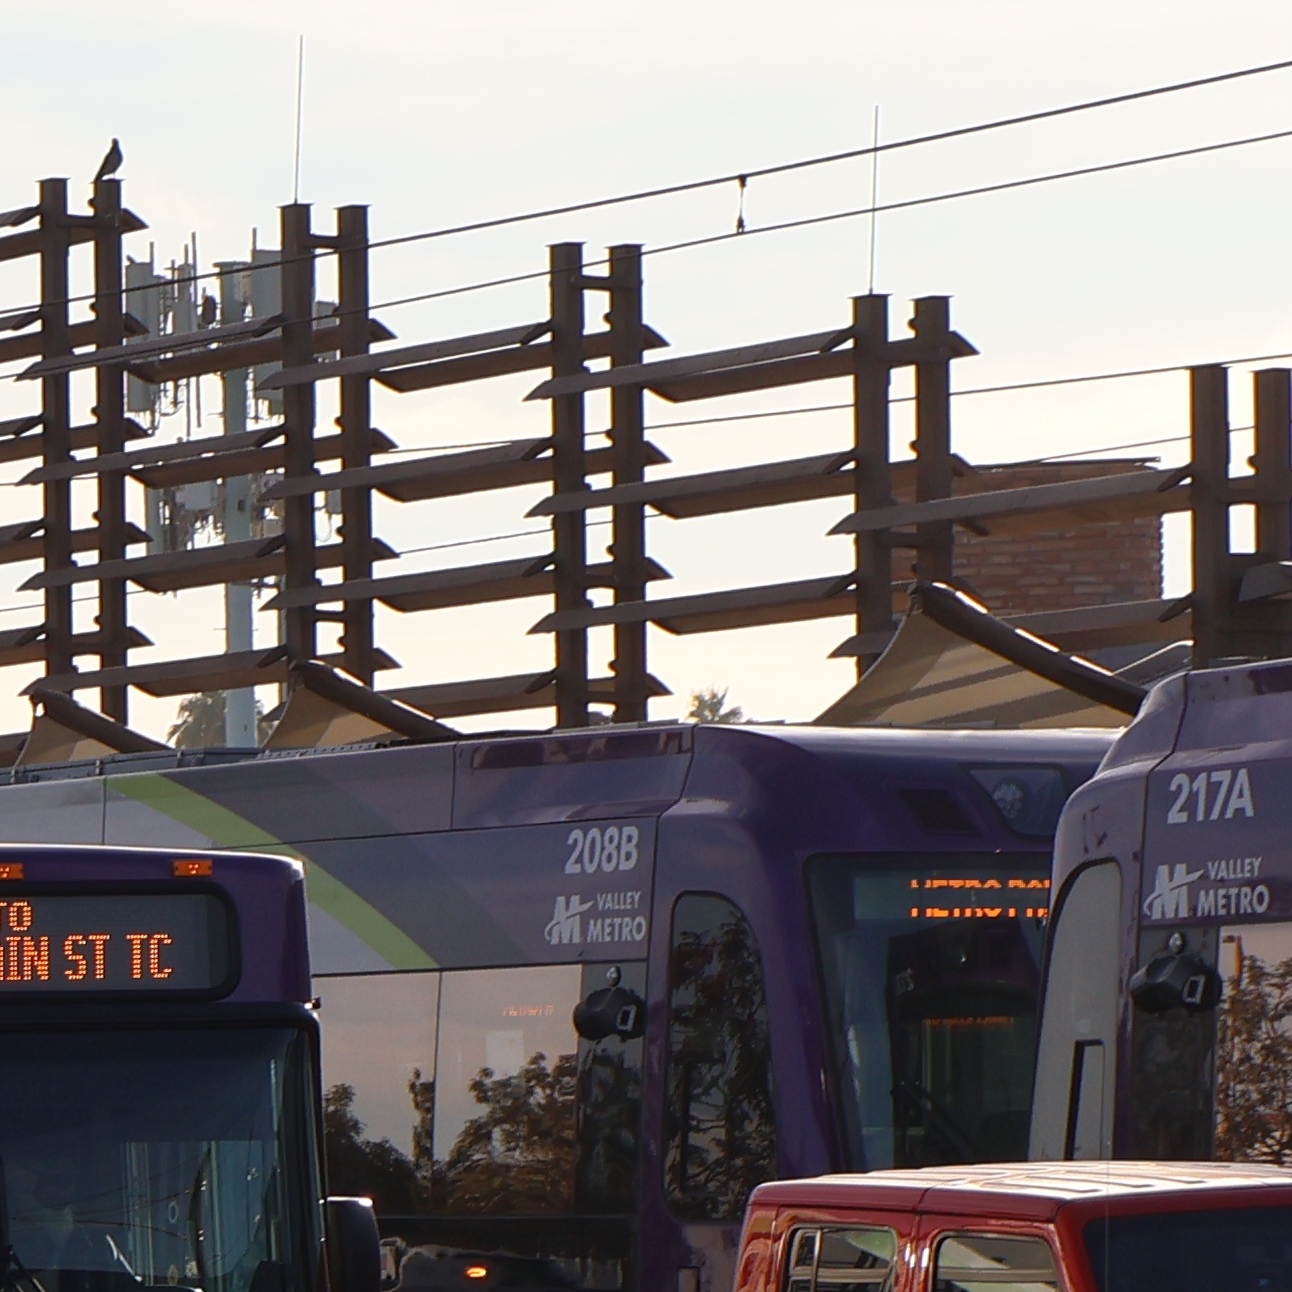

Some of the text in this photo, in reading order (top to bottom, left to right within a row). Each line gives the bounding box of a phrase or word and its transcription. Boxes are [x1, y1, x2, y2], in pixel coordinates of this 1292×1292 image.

[1167, 767, 1255, 825] 217A
[564, 825, 640, 875] 208B
[1207, 857, 1262, 881] VALLEY
[596, 890, 642, 912] VALLEY
[1197, 884, 1270, 918] METRO
[586, 915, 647, 944] METRO
[63, 934, 110, 981] ST
[125, 933, 174, 980] TC
